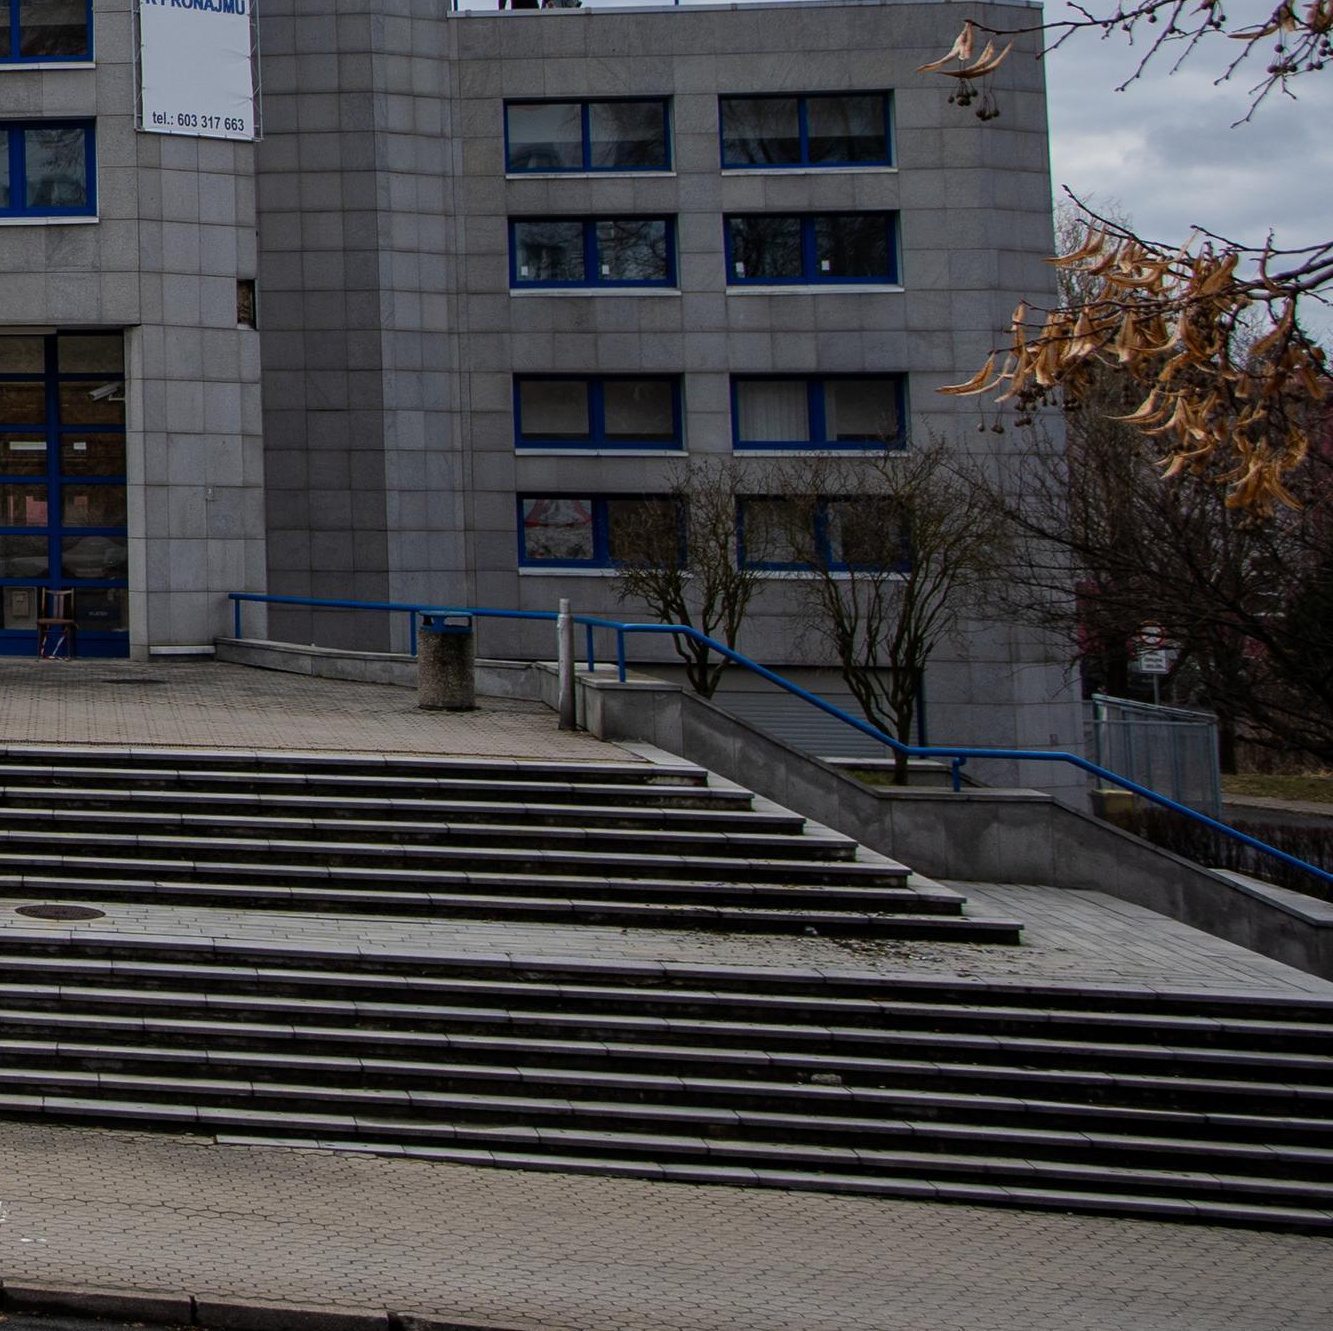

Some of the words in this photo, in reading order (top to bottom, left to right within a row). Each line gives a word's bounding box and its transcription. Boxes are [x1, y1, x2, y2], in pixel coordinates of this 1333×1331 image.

[152, 111, 174, 125] tel.:
[177, 113, 198, 128] 603
[201, 115, 221, 129] 317
[224, 117, 245, 132] 663
